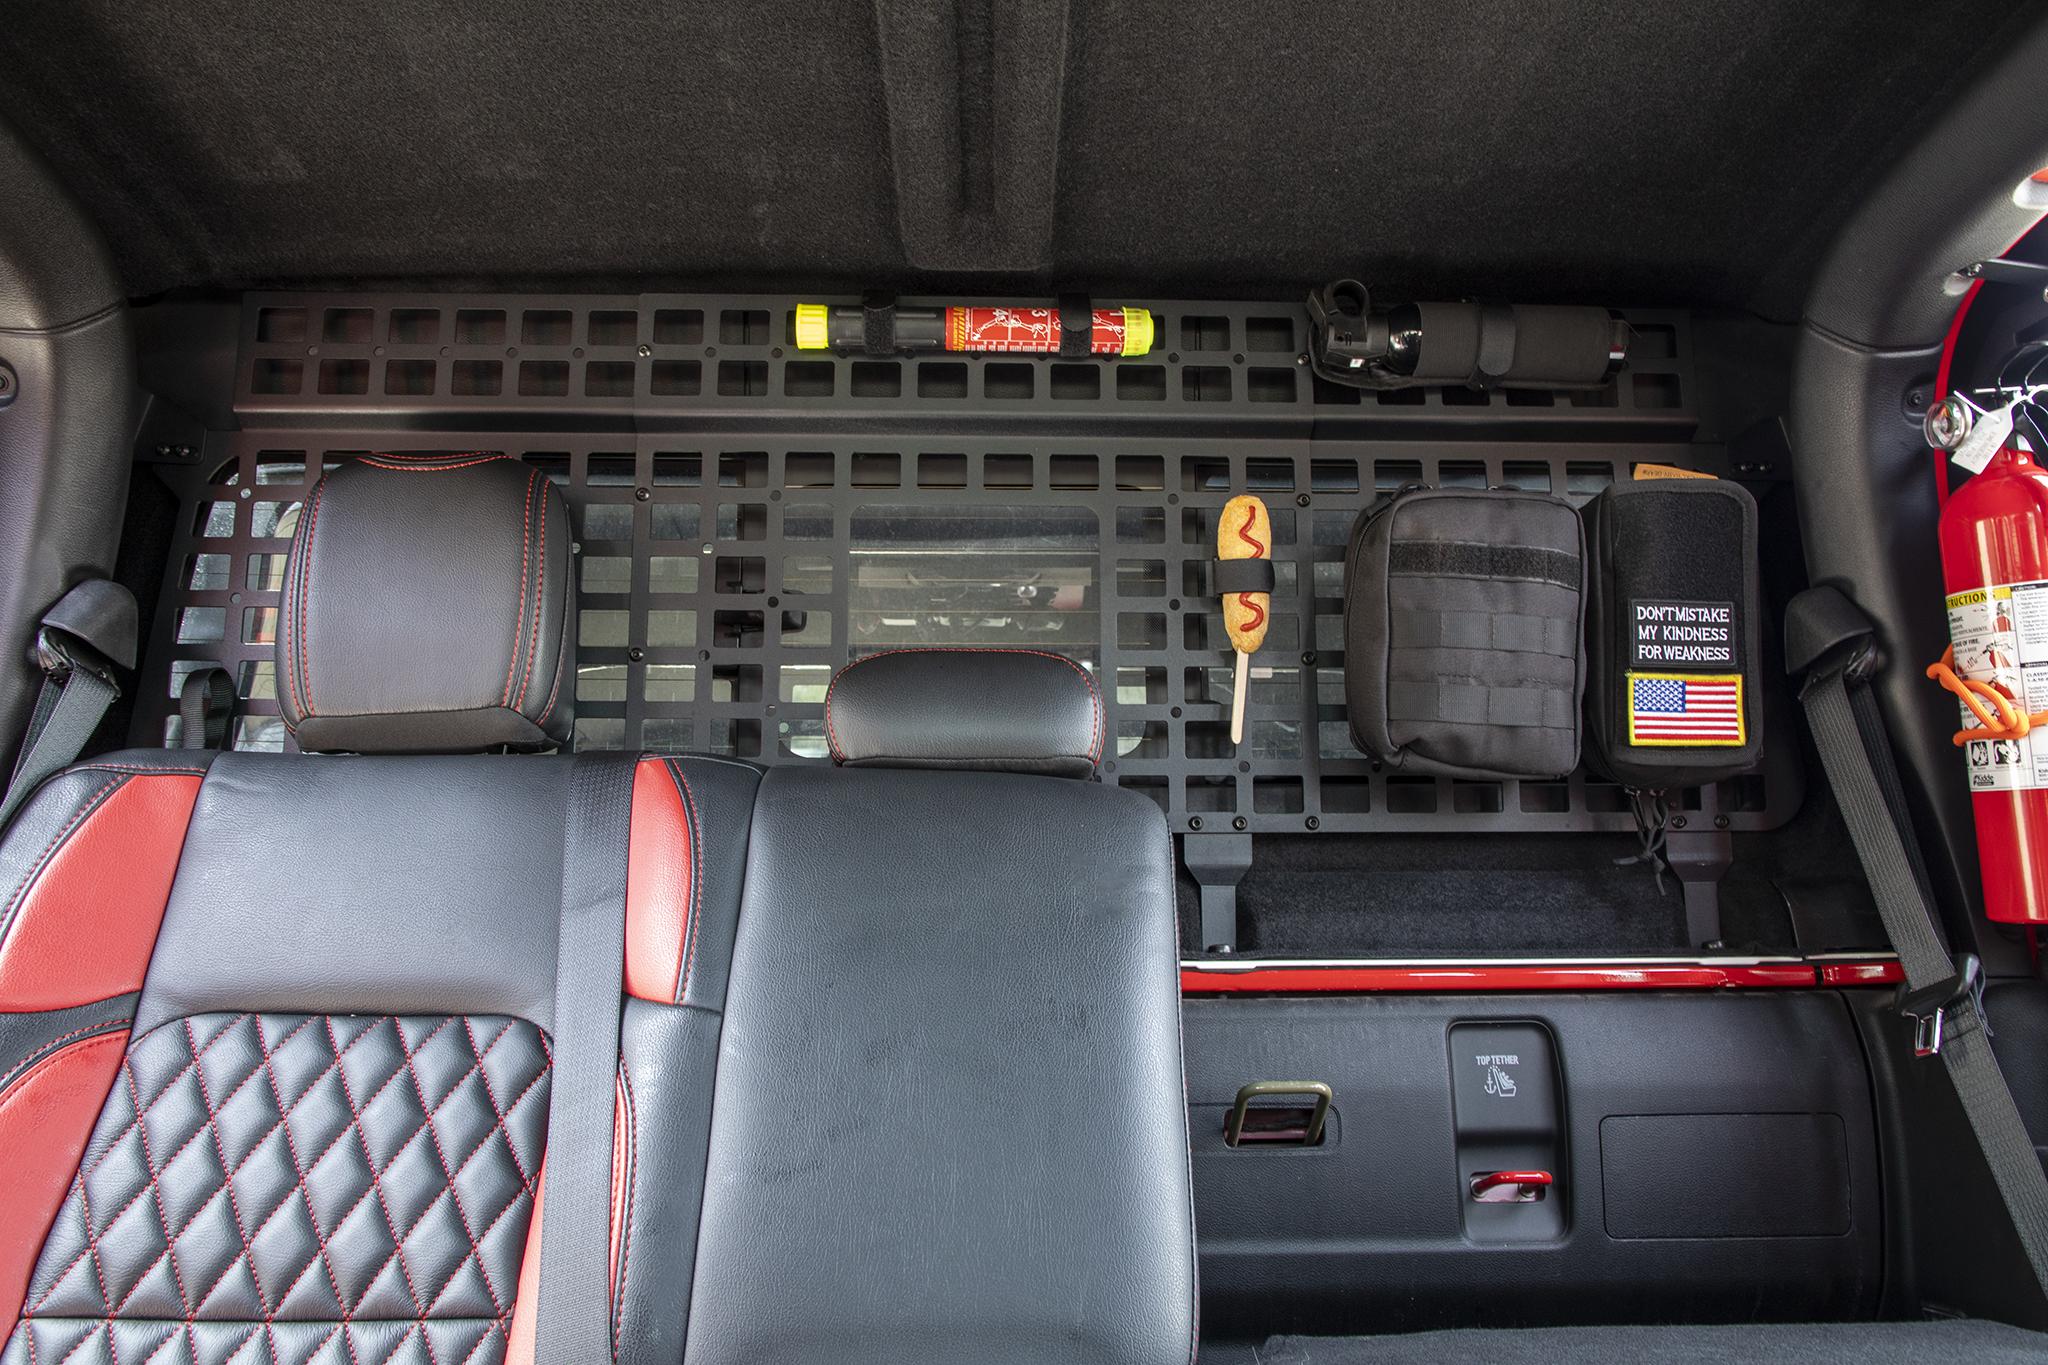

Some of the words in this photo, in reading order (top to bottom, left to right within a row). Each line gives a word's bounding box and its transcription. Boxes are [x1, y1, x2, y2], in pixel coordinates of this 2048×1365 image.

[1636, 606, 1675, 621] DON'T
[1676, 607, 1730, 623] MISTAKE
[1638, 625, 1658, 640] MY
[1663, 625, 1728, 641] KINDNESS
[1638, 645, 1662, 660] FOR
[1663, 645, 1730, 661] WEAKNESS
[1475, 1055, 1490, 1066] TOP
[1491, 1055, 1519, 1065] TETHER
